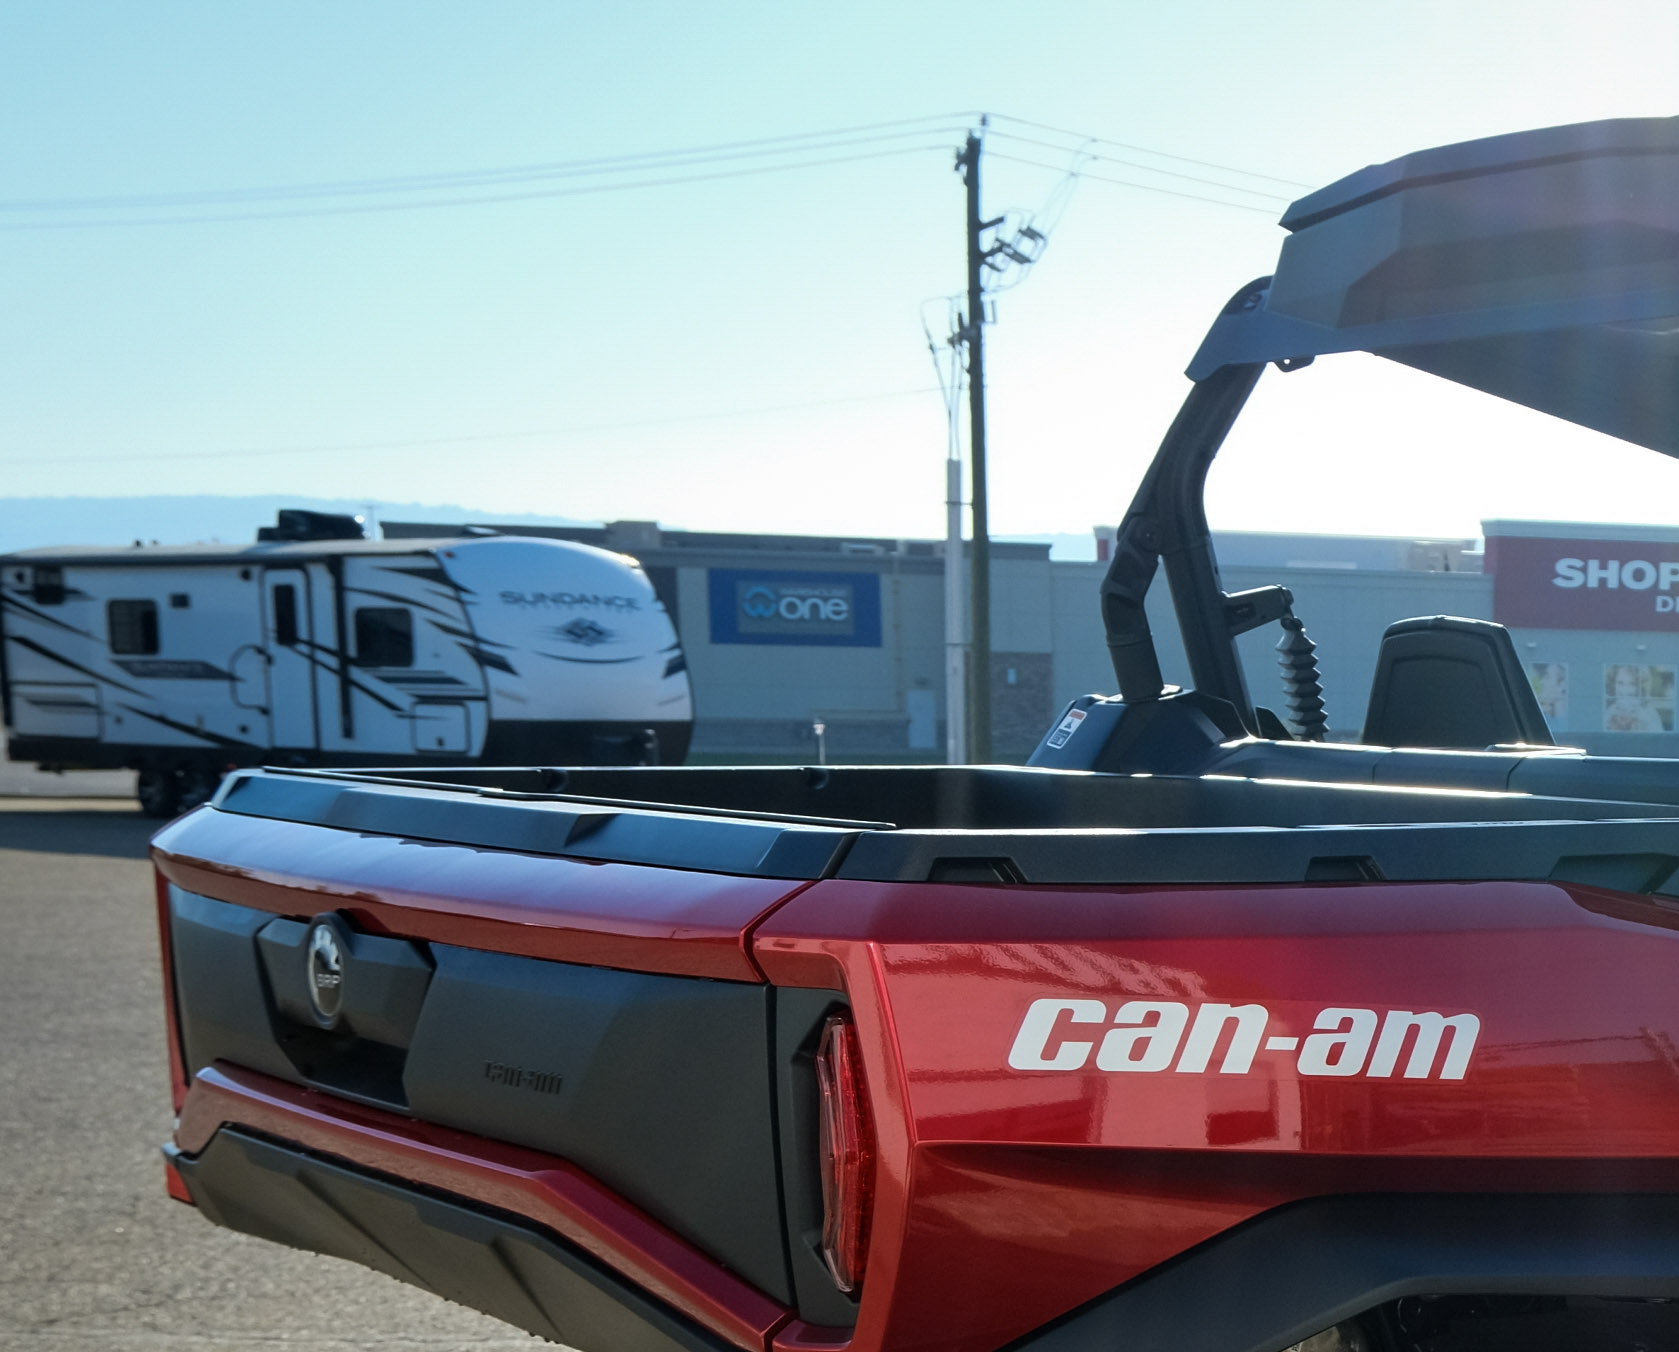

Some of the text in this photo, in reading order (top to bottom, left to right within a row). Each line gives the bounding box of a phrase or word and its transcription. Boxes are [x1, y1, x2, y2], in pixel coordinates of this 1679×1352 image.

[498, 590, 641, 611] SUNDANCE
[779, 597, 849, 621] one
[1008, 998, 1481, 1080] can-am
